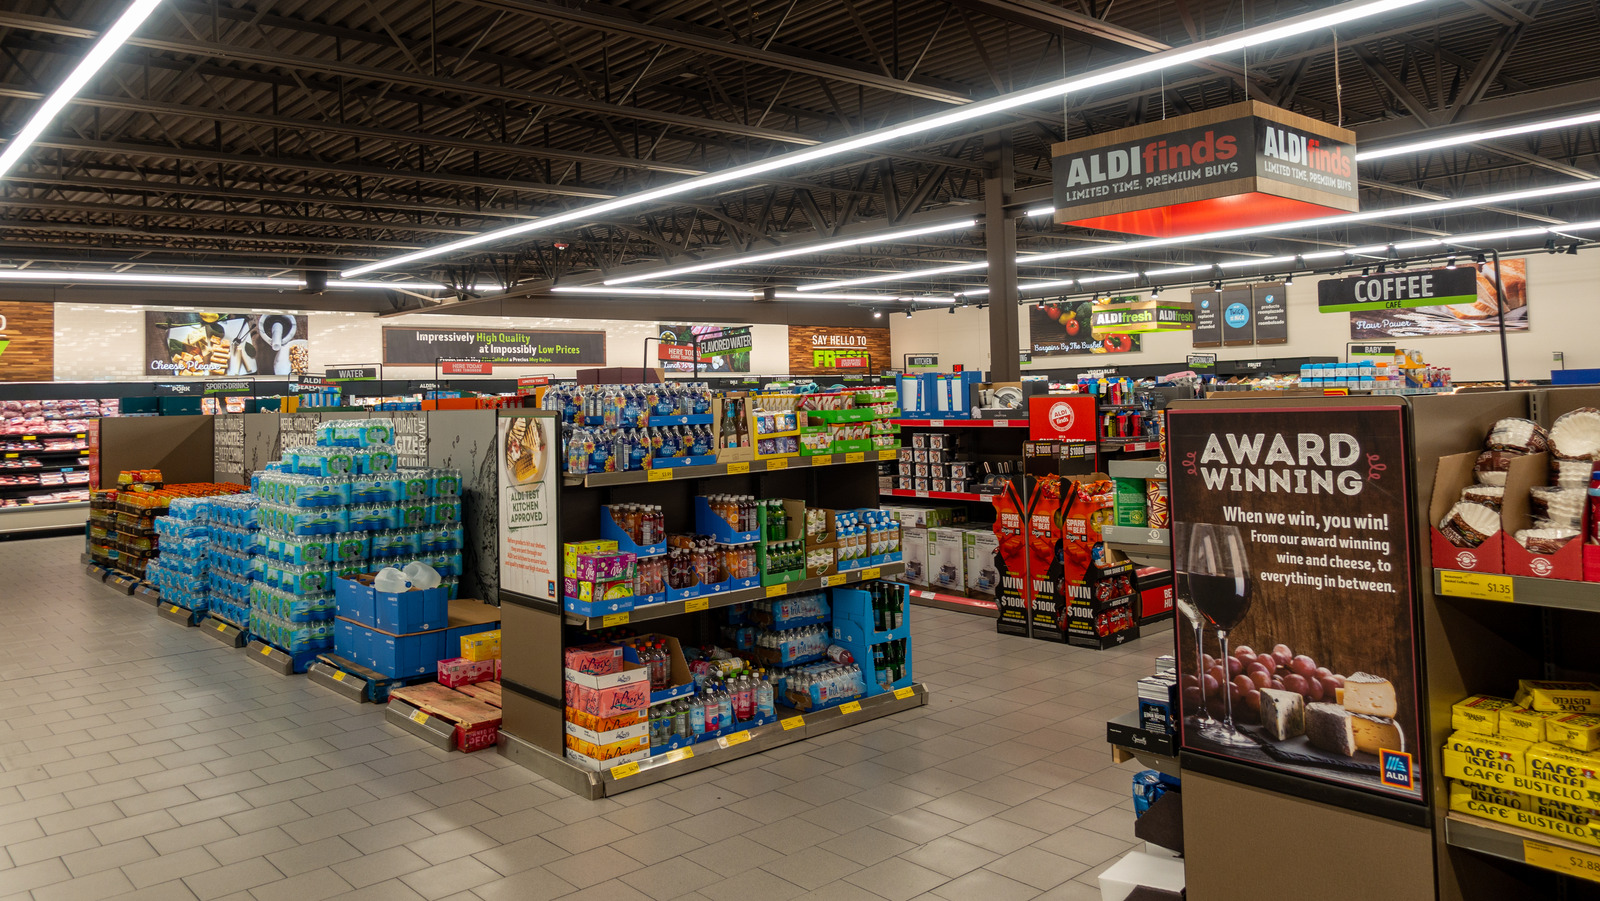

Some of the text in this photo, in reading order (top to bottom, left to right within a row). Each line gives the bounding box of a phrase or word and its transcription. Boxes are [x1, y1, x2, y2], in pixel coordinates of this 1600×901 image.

[1066, 161, 1239, 202] LIMITED TIME, PREMIUM BUYS
[1264, 160, 1352, 192] LIMITED TIME, PREMIUM BUYS
[1354, 274, 1434, 302] COFFEE
[1356, 319, 1412, 331] Flour Power
[416, 331, 530, 344] Impressively High Quality
[701, 335, 752, 354] FLAVORED WATER
[812, 335, 866, 346] SAY HELLO TO
[479, 345, 580, 356] at Impossibly Low Prices
[1034, 341, 1102, 354] Bargains By The Bushel
[151, 360, 220, 370] Cheese Please
[339, 370, 364, 378] WATER
[393, 417, 417, 433] YDRATE
[281, 433, 314, 448] ENERGIZE
[1200, 432, 1361, 467] AWARD
[1200, 467, 1363, 496] WINNING
[511, 490, 539, 501] ALDI TEST
[513, 501, 538, 512] KITCHEN
[511, 512, 542, 523] APPROVED
[1066, 519, 1085, 527] SPARK
[1222, 506, 1389, 532] When we win, you win!
[1250, 530, 1390, 555] From our award winning
[1276, 552, 1392, 573] wine and cheese, to
[1002, 576, 1023, 590] WIN
[1033, 580, 1054, 593] WIN
[1260, 570, 1396, 593] everything in between.
[1488, 582, 1510, 594] $1.35
[1068, 585, 1091, 599] WIN
[1001, 596, 1026, 608] $100K
[1032, 600, 1056, 612] $100K
[1067, 605, 1094, 618] $100K
[610, 690, 644, 709] LaCroix
[1553, 696, 1591, 706] BUSTELO
[1468, 756, 1515, 773] STELO
[1386, 771, 1408, 782] ALDI
[1514, 777, 1582, 801] BUSTELO
[1471, 790, 1521, 809] USTELO
[1518, 812, 1585, 837] BUSTELO
[1570, 856, 1600, 872] $2.88
